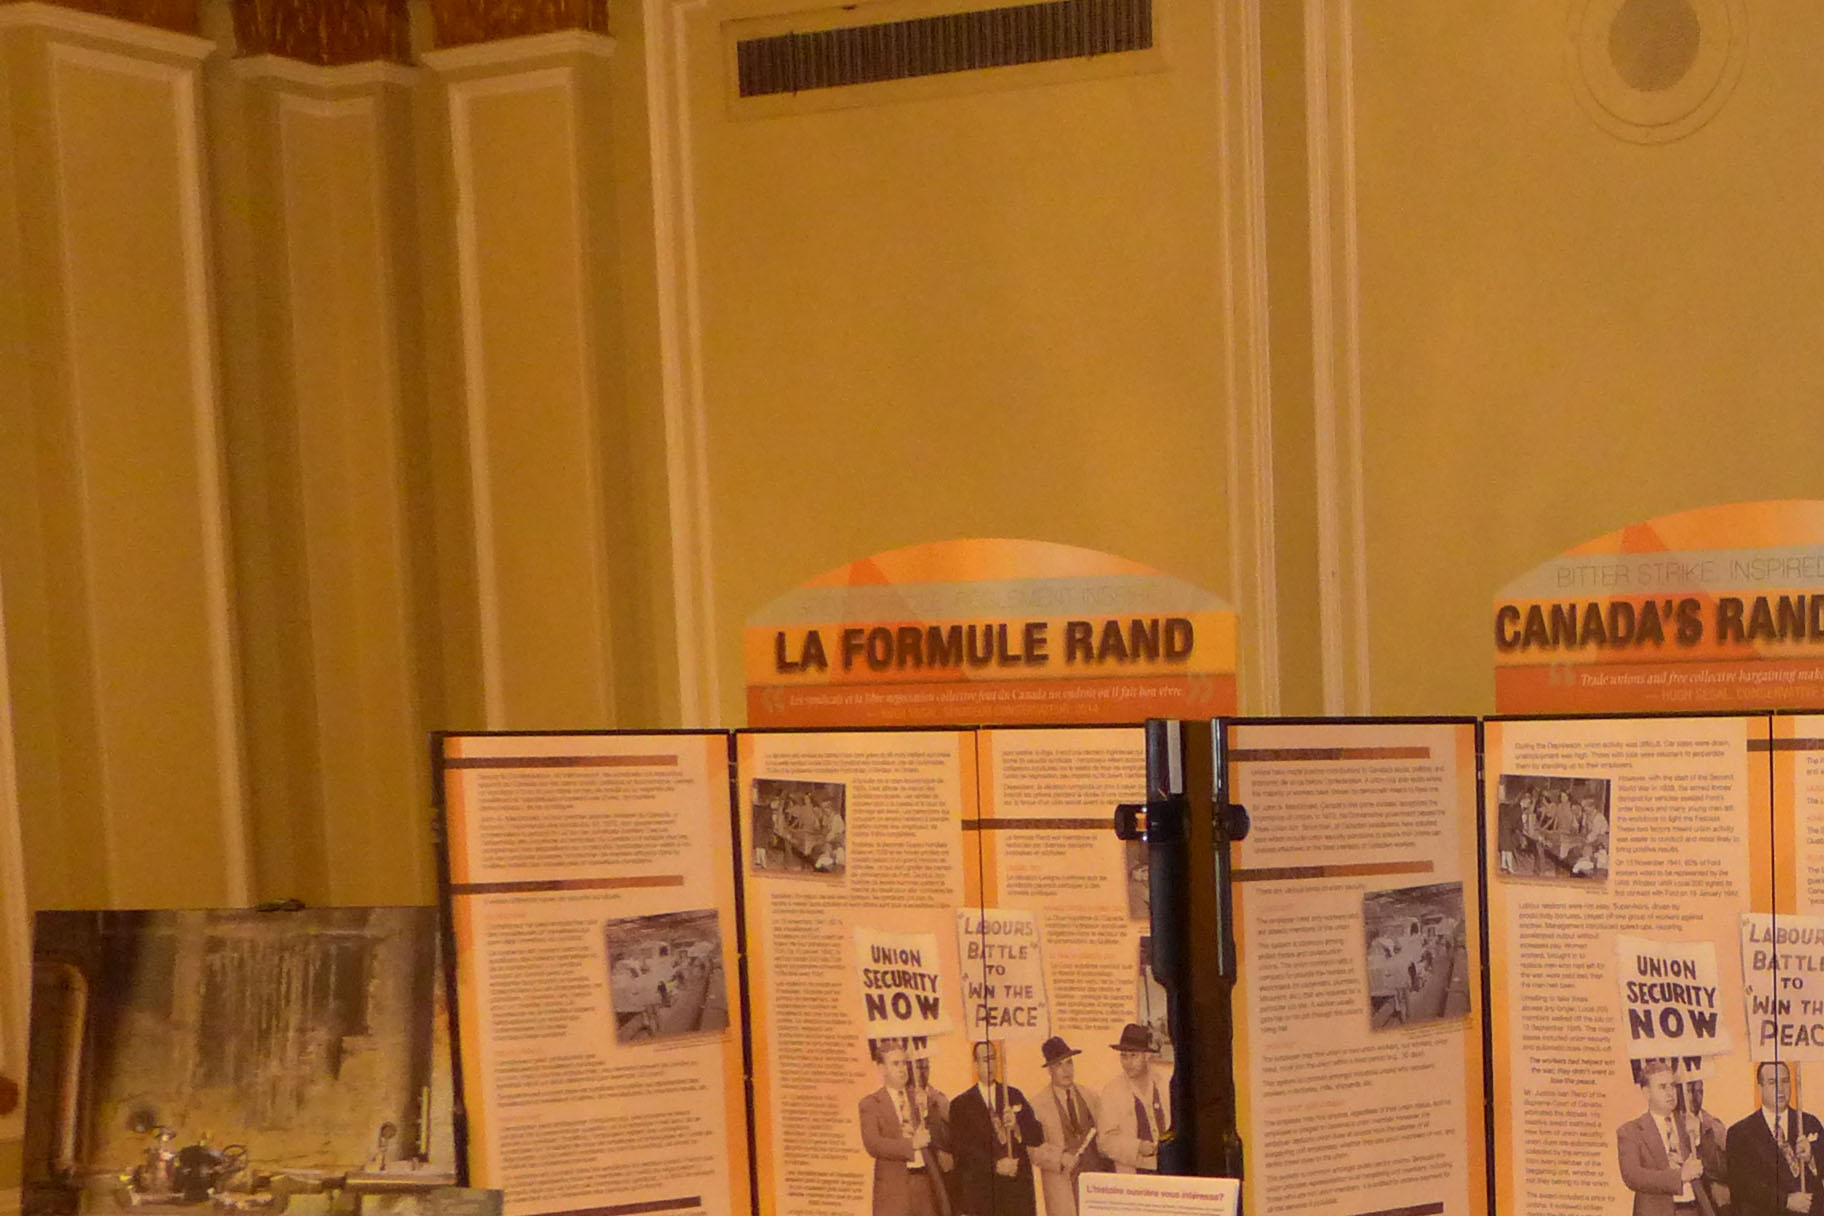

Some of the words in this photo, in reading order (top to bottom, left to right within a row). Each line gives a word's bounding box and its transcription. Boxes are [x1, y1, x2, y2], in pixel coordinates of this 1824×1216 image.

[1557, 565, 1630, 588] BITTER
[1495, 597, 1704, 652] CANADA'S
[775, 630, 829, 674] LA
[841, 622, 1050, 671] FORMULE
[1065, 618, 1195, 665] RAND
[1646, 671, 1669, 684] and
[870, 944, 923, 967] UNION
[1636, 954, 1697, 981] UNION
[863, 968, 940, 994] SECURITY
[986, 964, 1006, 976] TO
[1004, 985, 1034, 999] THE
[1626, 980, 1717, 1009] SECURITY
[1780, 977, 1804, 990] TO
[864, 992, 940, 1022] NOW
[1628, 1007, 1718, 1040] NOW
